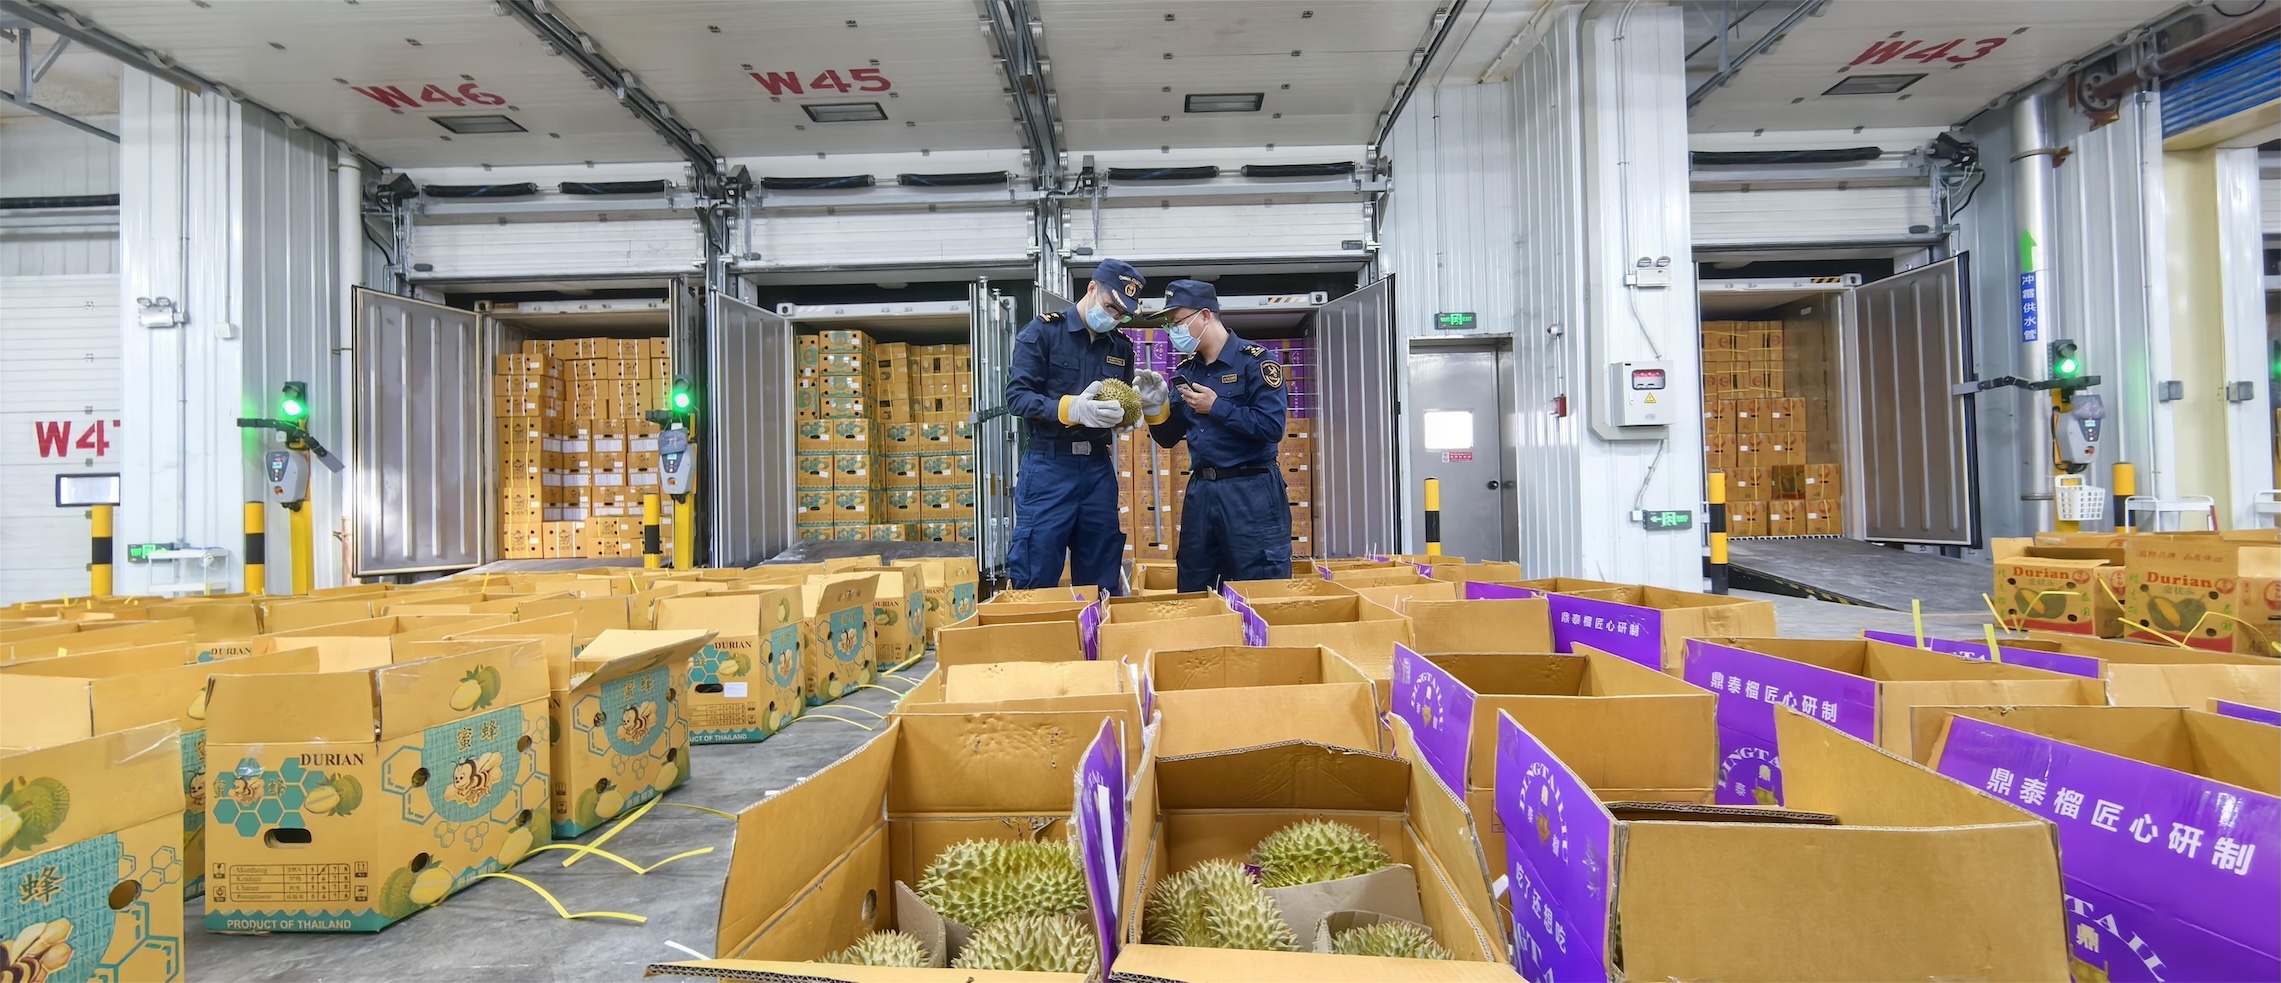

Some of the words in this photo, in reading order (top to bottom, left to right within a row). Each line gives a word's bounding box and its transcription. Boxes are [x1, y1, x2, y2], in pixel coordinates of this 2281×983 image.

[1849, 37, 2008, 65] W43
[749, 68, 891, 95] W45
[350, 83, 506, 108] W46
[35, 419, 121, 458] W4
[2013, 567, 2070, 580] Durian
[2146, 571, 2211, 588] Durian
[1560, 611, 1640, 637] 鼎泰榴匠心研制
[210, 647, 252, 656] DURIAN
[714, 641, 752, 649] DURIAN
[1710, 671, 1838, 723] 鼎泰榴匠心研制
[456, 719, 498, 751] 蜜蜂
[301, 753, 364, 766] DURIAN
[1985, 767, 2256, 876] 鼎泰榴匠心研制
[19, 866, 66, 905] 蜂
[1515, 861, 1567, 954] 吃了还想吃
[227, 919, 278, 930] PRODUCT
[279, 919, 295, 929] OF
[298, 919, 352, 930] THAILAND
